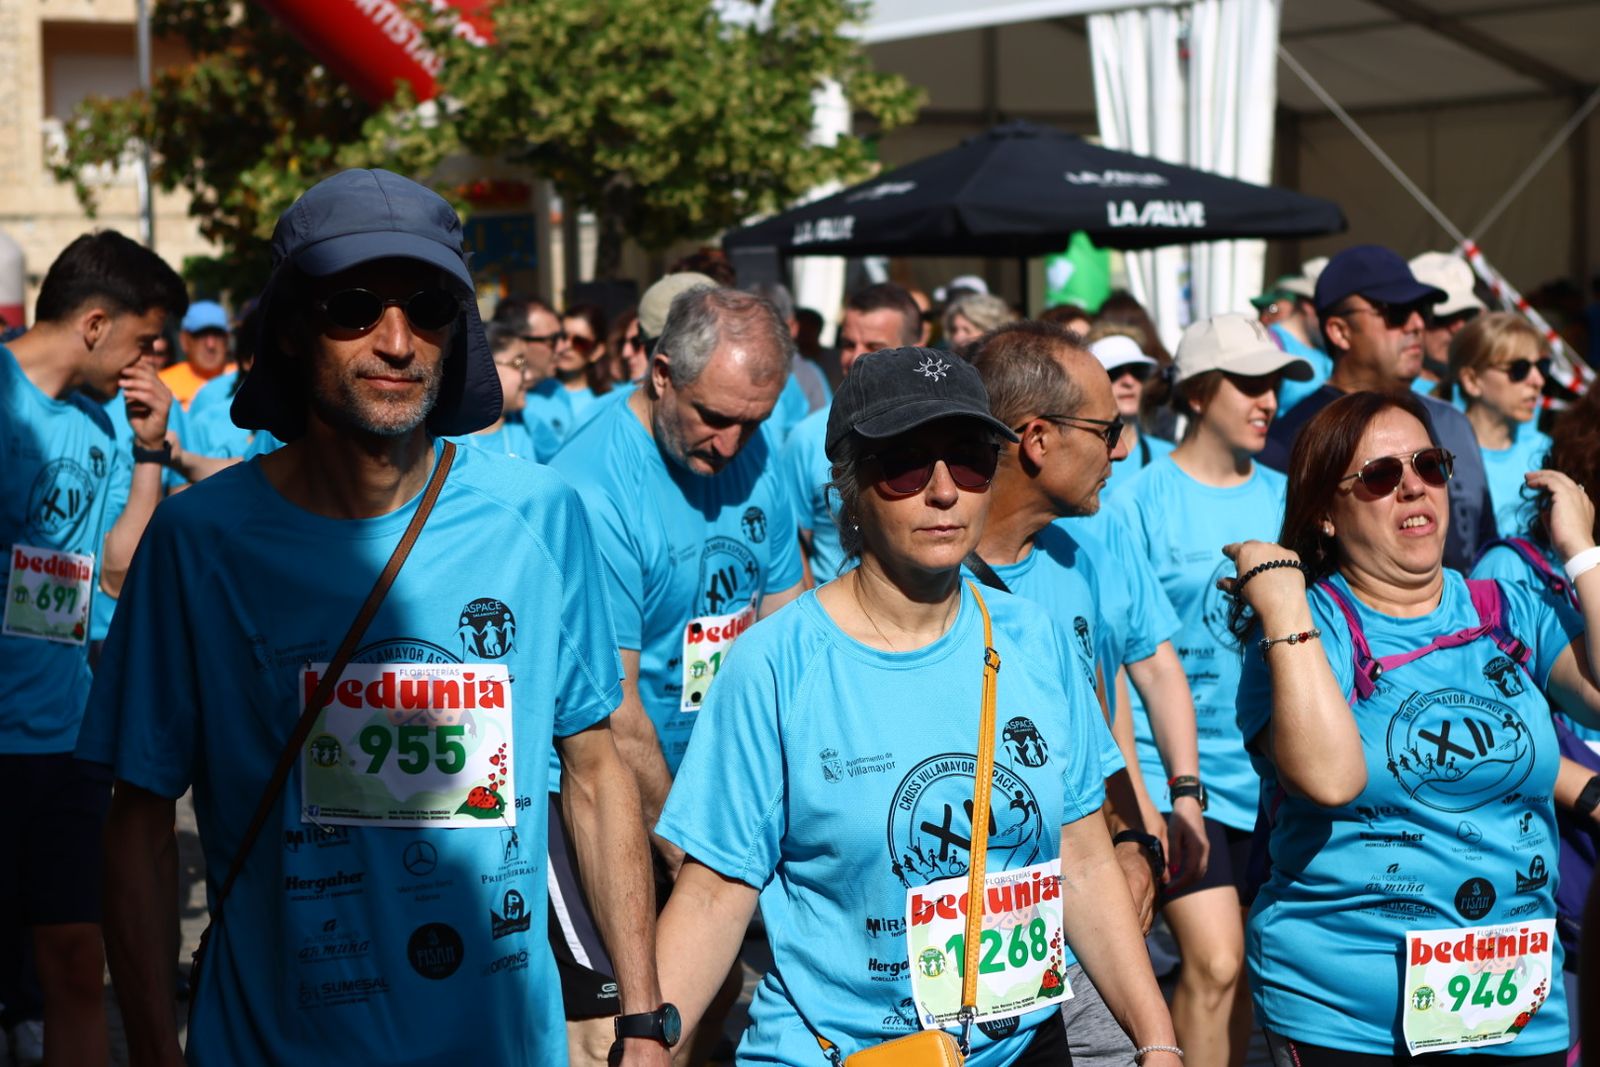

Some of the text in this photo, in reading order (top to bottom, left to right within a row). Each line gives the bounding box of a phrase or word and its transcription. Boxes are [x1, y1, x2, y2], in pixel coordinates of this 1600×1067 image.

[36, 582, 77, 615] 697
[463, 600, 502, 614] ASPACE
[399, 667, 460, 677] FLORISTERÍAS
[305, 671, 504, 709] bedunia
[1469, 697, 1503, 716] ASPACE
[1006, 719, 1034, 730] ASPACE
[359, 725, 466, 774] 955
[1418, 717, 1495, 766] XII
[846, 756, 884, 767] Ayuntamiento
[847, 761, 896, 778] Villamayor
[899, 779, 923, 811] CROSS
[917, 761, 974, 785] VILLAMAYOR
[285, 871, 367, 892] Hergaher
[1370, 874, 1418, 882] AUTOCARES
[945, 917, 1048, 979] 1268
[1411, 927, 1549, 966] bedunia
[868, 956, 910, 977] Herga
[1447, 969, 1518, 1012] 946
